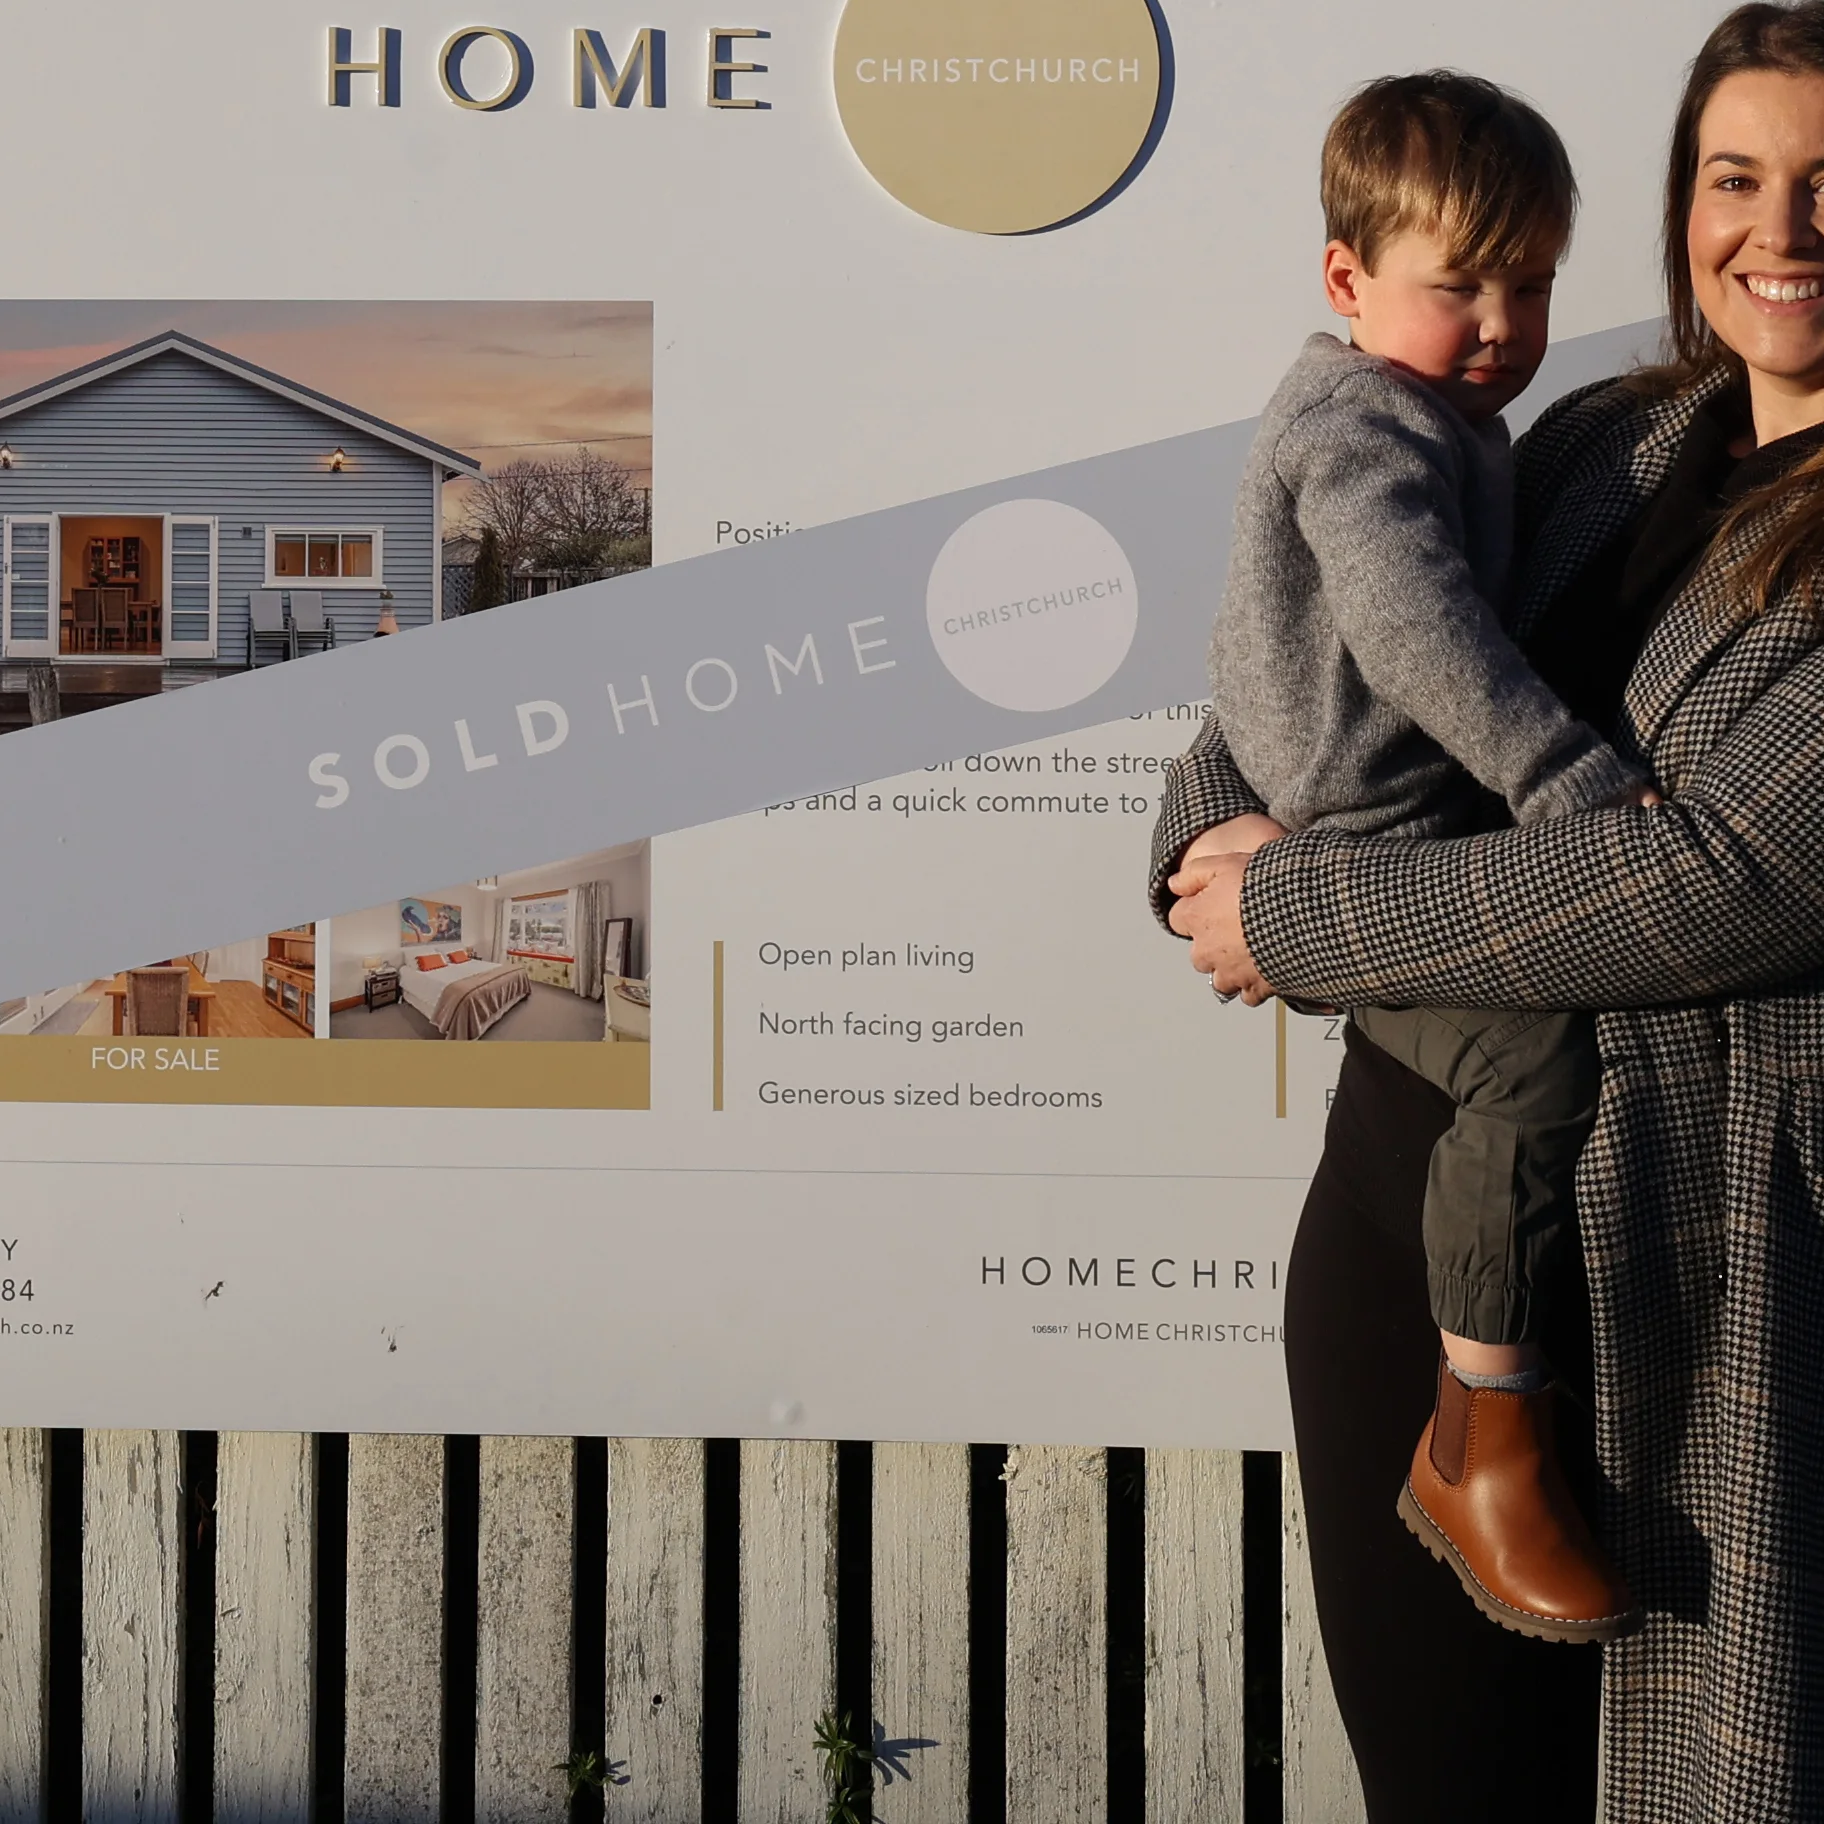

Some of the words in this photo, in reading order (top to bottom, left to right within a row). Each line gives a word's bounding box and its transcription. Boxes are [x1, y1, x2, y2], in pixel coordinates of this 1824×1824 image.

[327, 25, 772, 112] HOME
[855, 56, 1140, 84] CHRISTCHURCH
[308, 699, 570, 809] SOLD
[606, 614, 897, 736] HOME
[943, 577, 1124, 636] CHRISTCHURCH
[964, 751, 1041, 773] down
[1051, 747, 1097, 774] the
[1106, 753, 1175, 774] stree
[805, 785, 856, 811] and
[867, 794, 882, 812] a
[892, 787, 967, 819] quick
[976, 792, 1109, 814] commute
[1118, 792, 1148, 814] to
[758, 942, 832, 972] Open
[842, 942, 896, 972] plan
[907, 942, 974, 974] living
[759, 1011, 834, 1036] North
[842, 1011, 922, 1043] facing
[931, 1013, 1023, 1044] garden
[92, 1047, 146, 1070] FOR
[154, 1047, 220, 1071] SALE
[758, 1081, 885, 1106] Generous
[893, 1082, 959, 1106] sized
[969, 1082, 1103, 1108] bedrooms
[982, 1256, 1277, 1290] HOMECHRI
[1077, 1322, 1150, 1340] HOME
